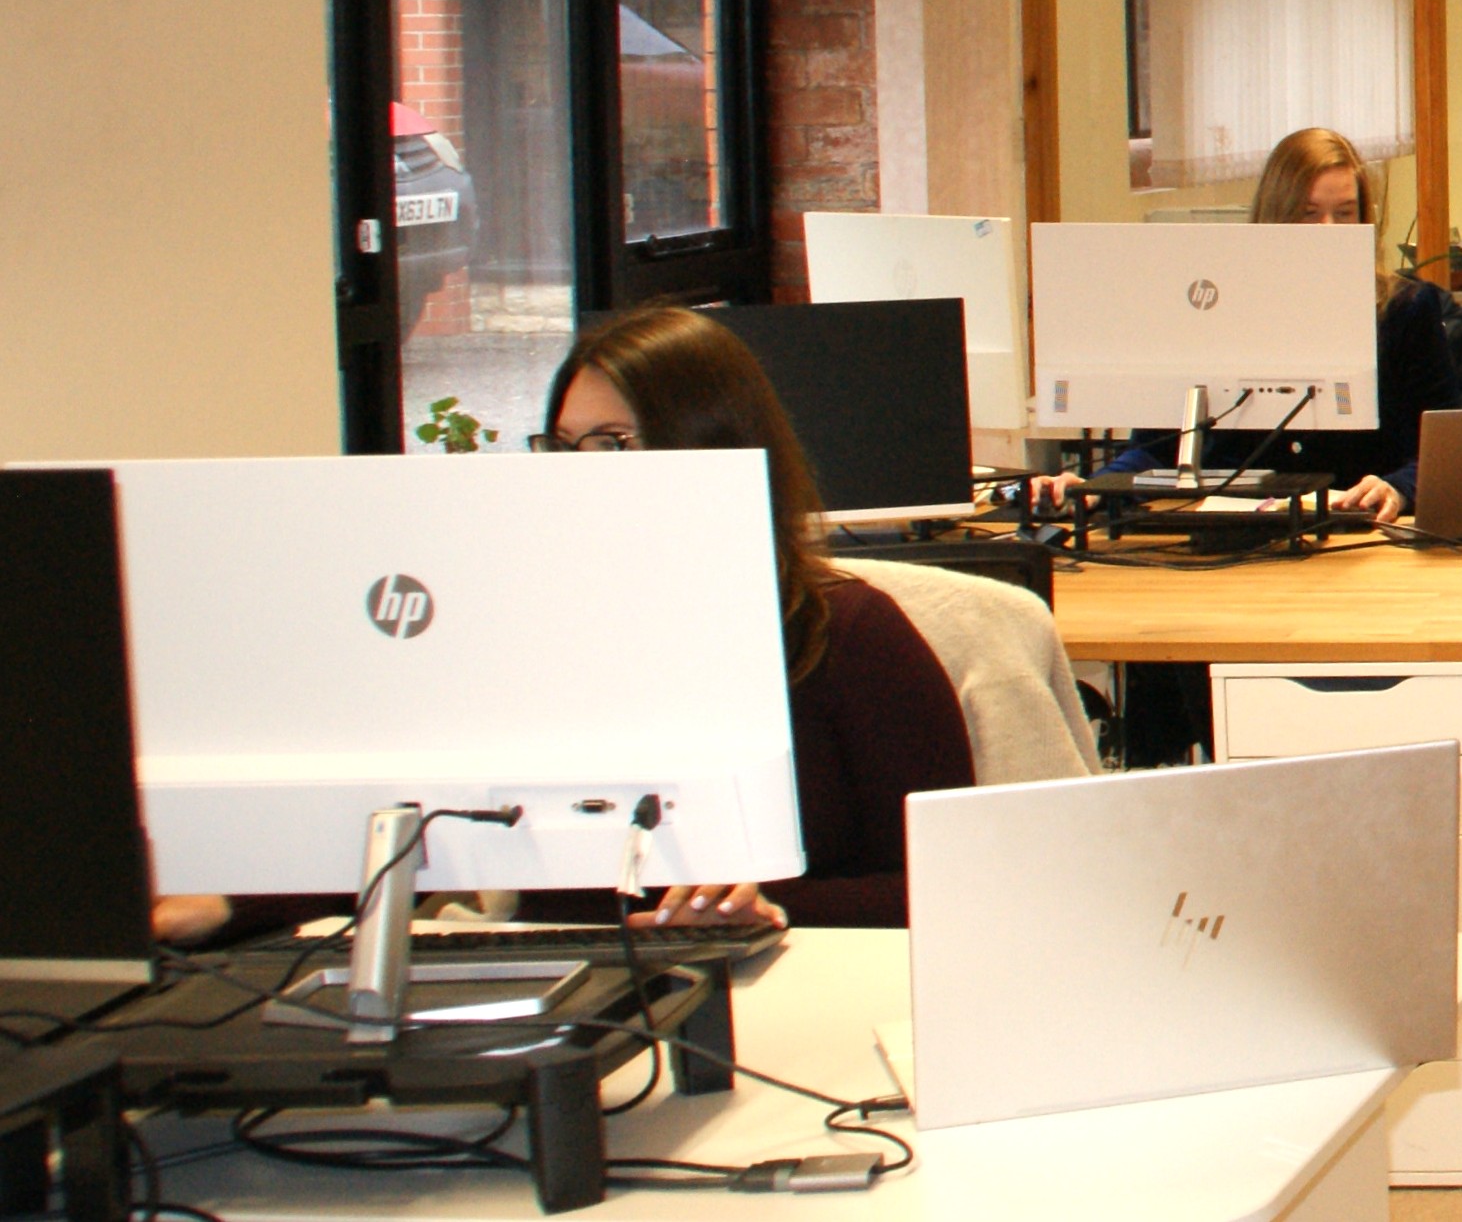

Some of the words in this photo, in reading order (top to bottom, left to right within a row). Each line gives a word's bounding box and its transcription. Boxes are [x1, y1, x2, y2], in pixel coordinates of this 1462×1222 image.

[398, 199, 424, 222] X63
[1190, 279, 1217, 310] hp
[372, 574, 430, 638] hp
